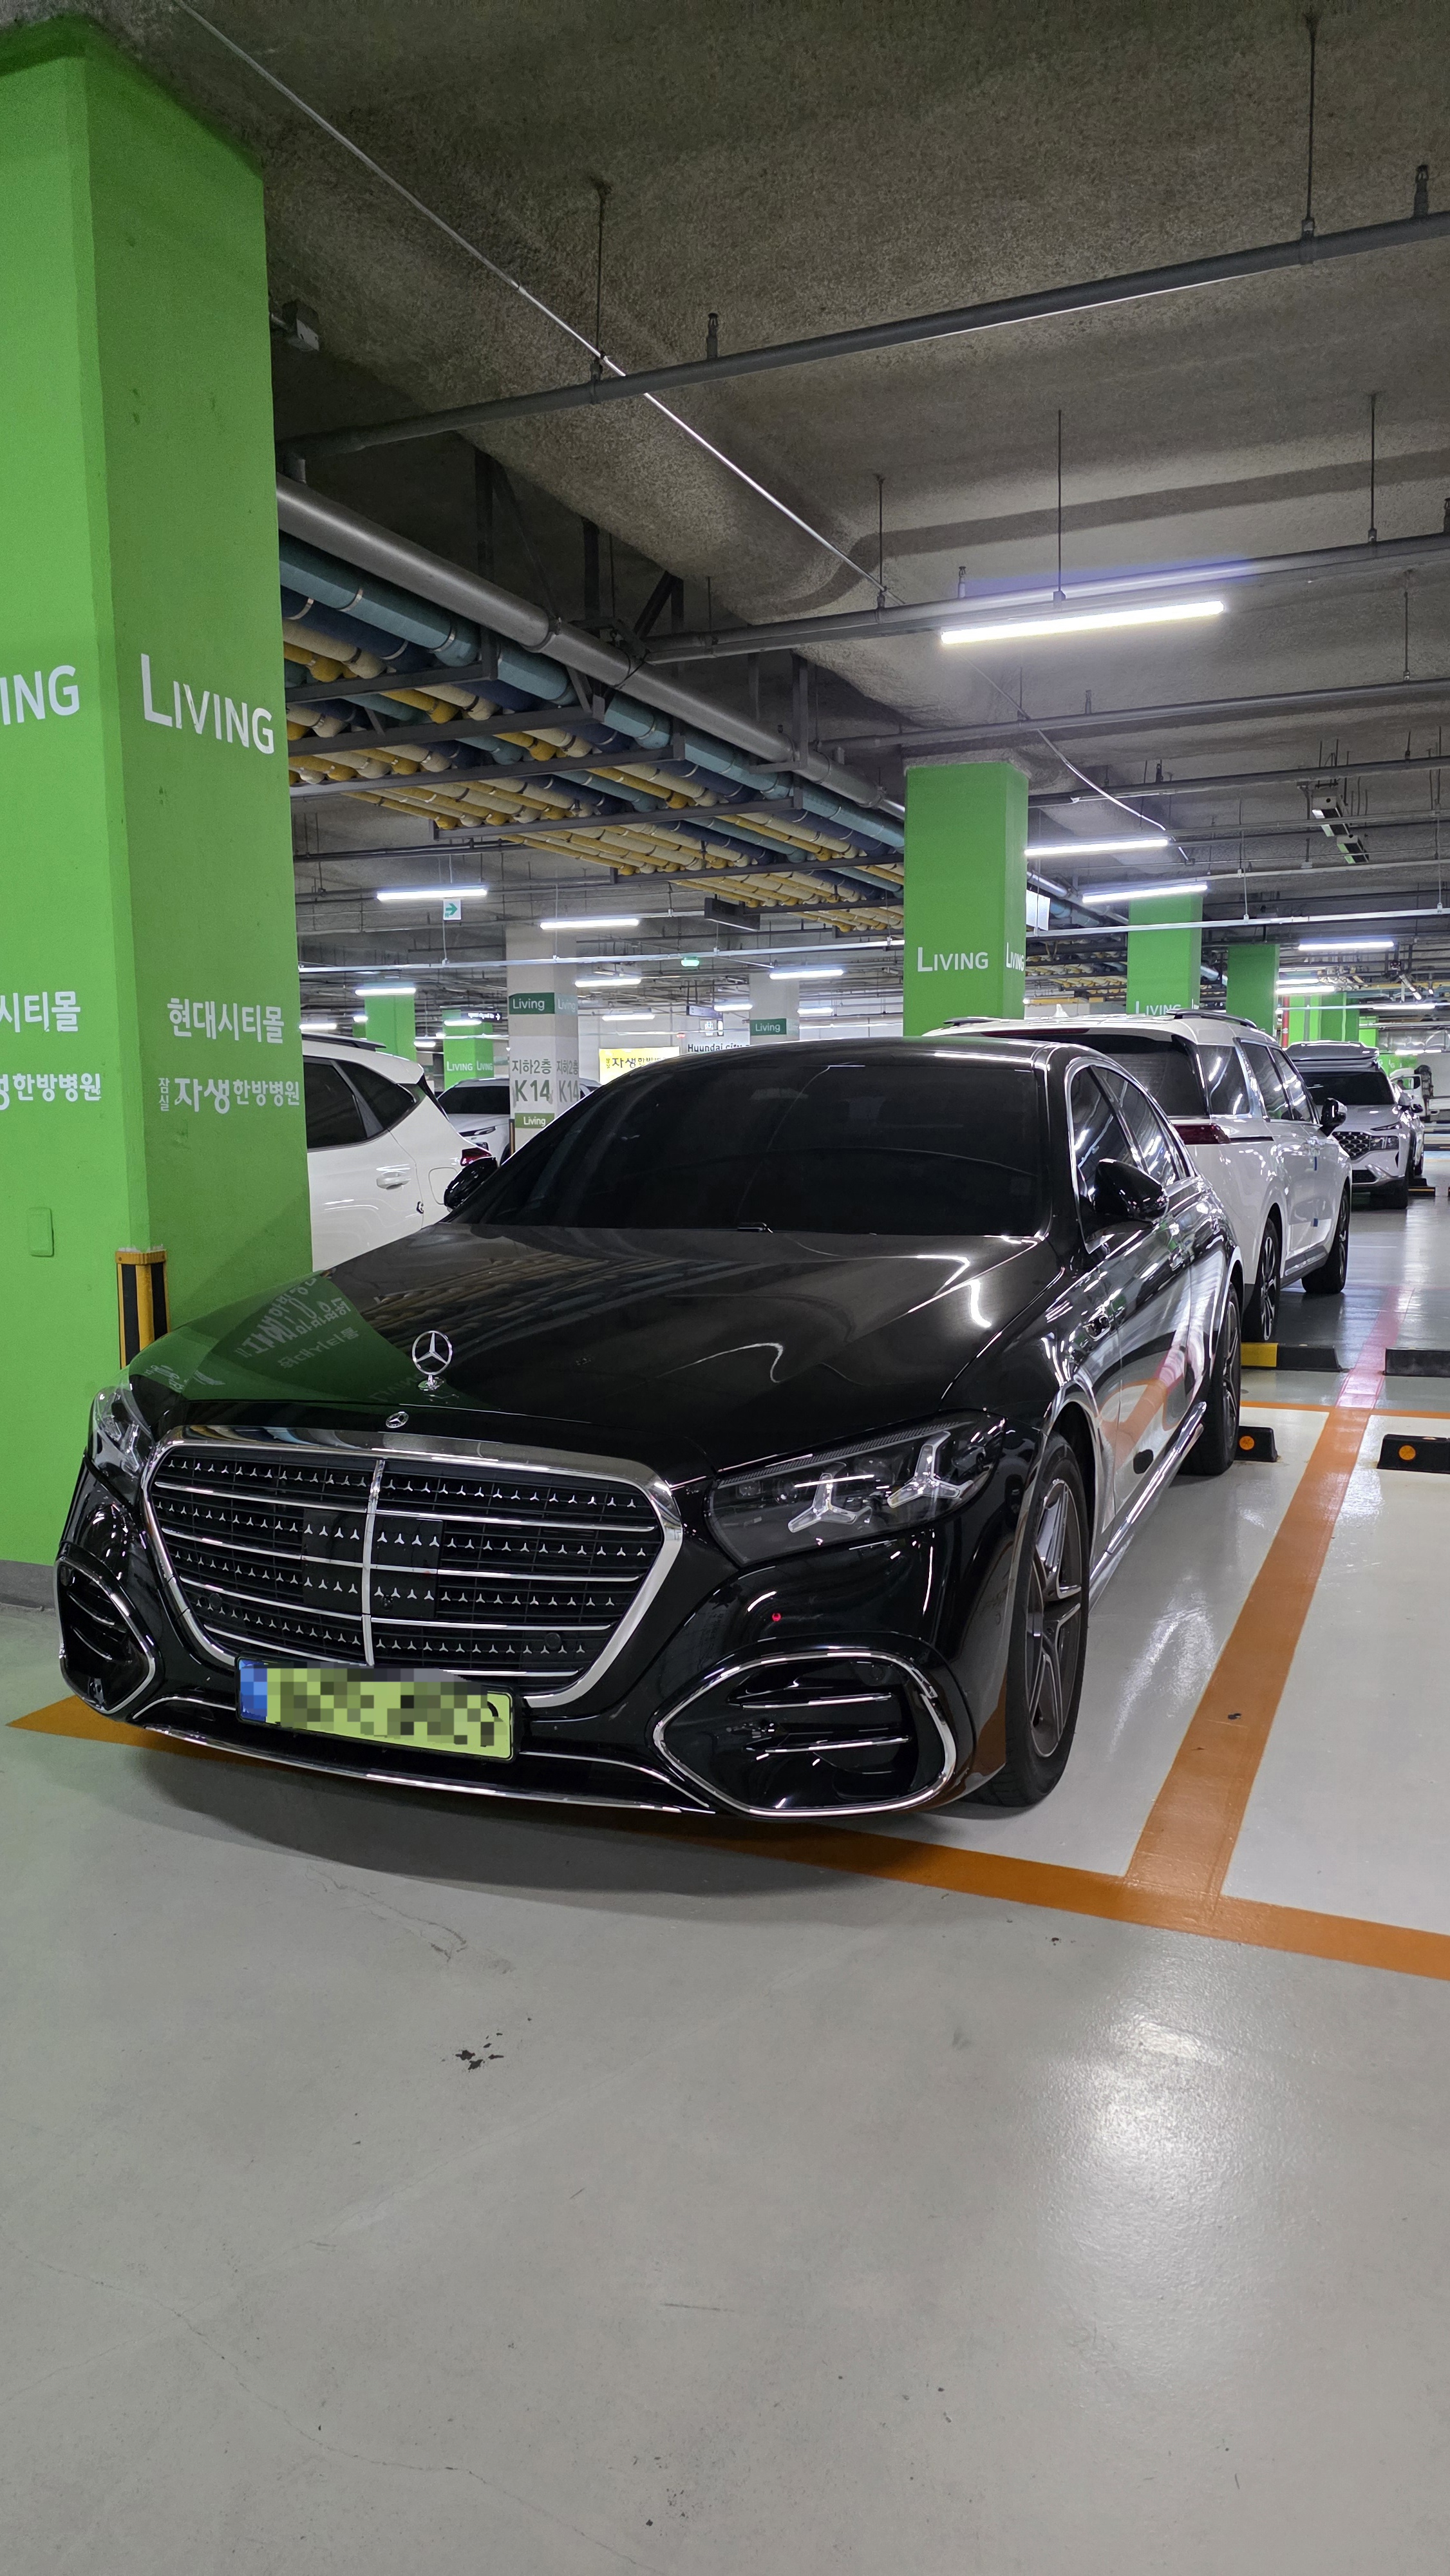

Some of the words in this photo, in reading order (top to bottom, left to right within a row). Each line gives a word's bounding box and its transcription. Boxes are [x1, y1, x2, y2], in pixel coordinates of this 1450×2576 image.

[140, 653, 274, 754] LIVING
[918, 947, 988, 972] LIVING
[513, 998, 545, 1011] Living
[558, 999, 576, 1012] Living
[167, 998, 285, 1044] 현대시티몰
[755, 1023, 780, 1032] Living
[512, 1059, 552, 1075] 지하2층
[556, 1060, 579, 1075] 지하2층
[515, 1080, 550, 1102] K14
[523, 1117, 546, 1127] Living
